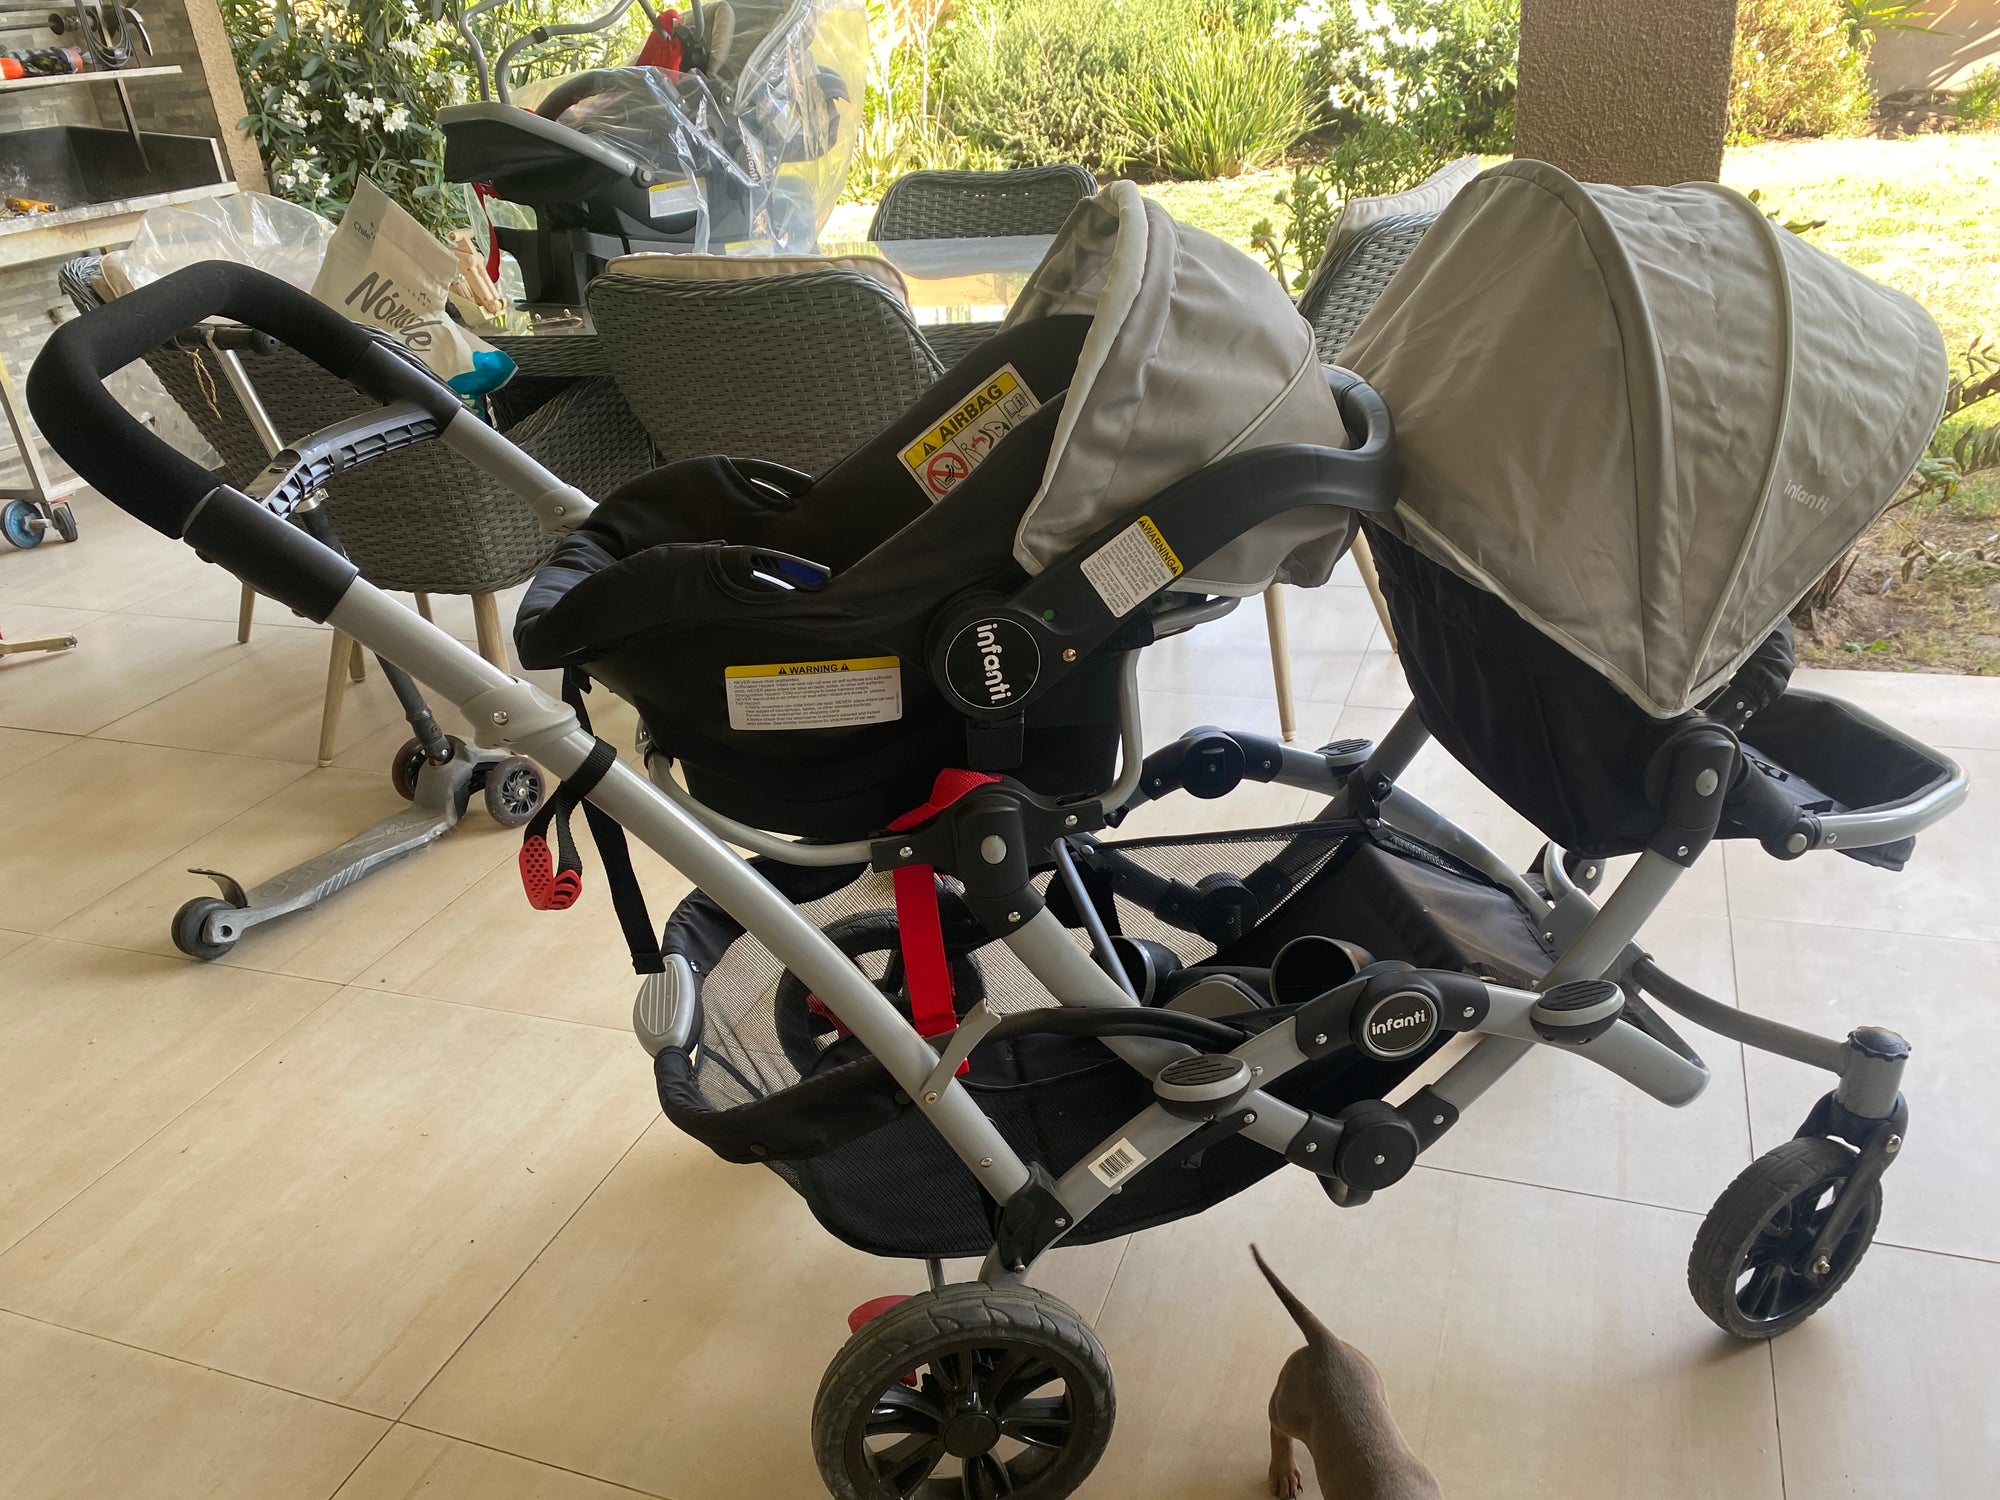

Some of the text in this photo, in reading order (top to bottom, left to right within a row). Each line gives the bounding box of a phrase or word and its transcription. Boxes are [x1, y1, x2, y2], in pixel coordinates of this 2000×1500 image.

[938, 384, 1003, 442] AIRBAG
[1783, 479, 1830, 511] infanti
[1143, 524, 1176, 569] WARNING
[789, 664, 838, 675] WARNING
[976, 623, 1012, 702] infanti
[1371, 1009, 1425, 1035] infanti
